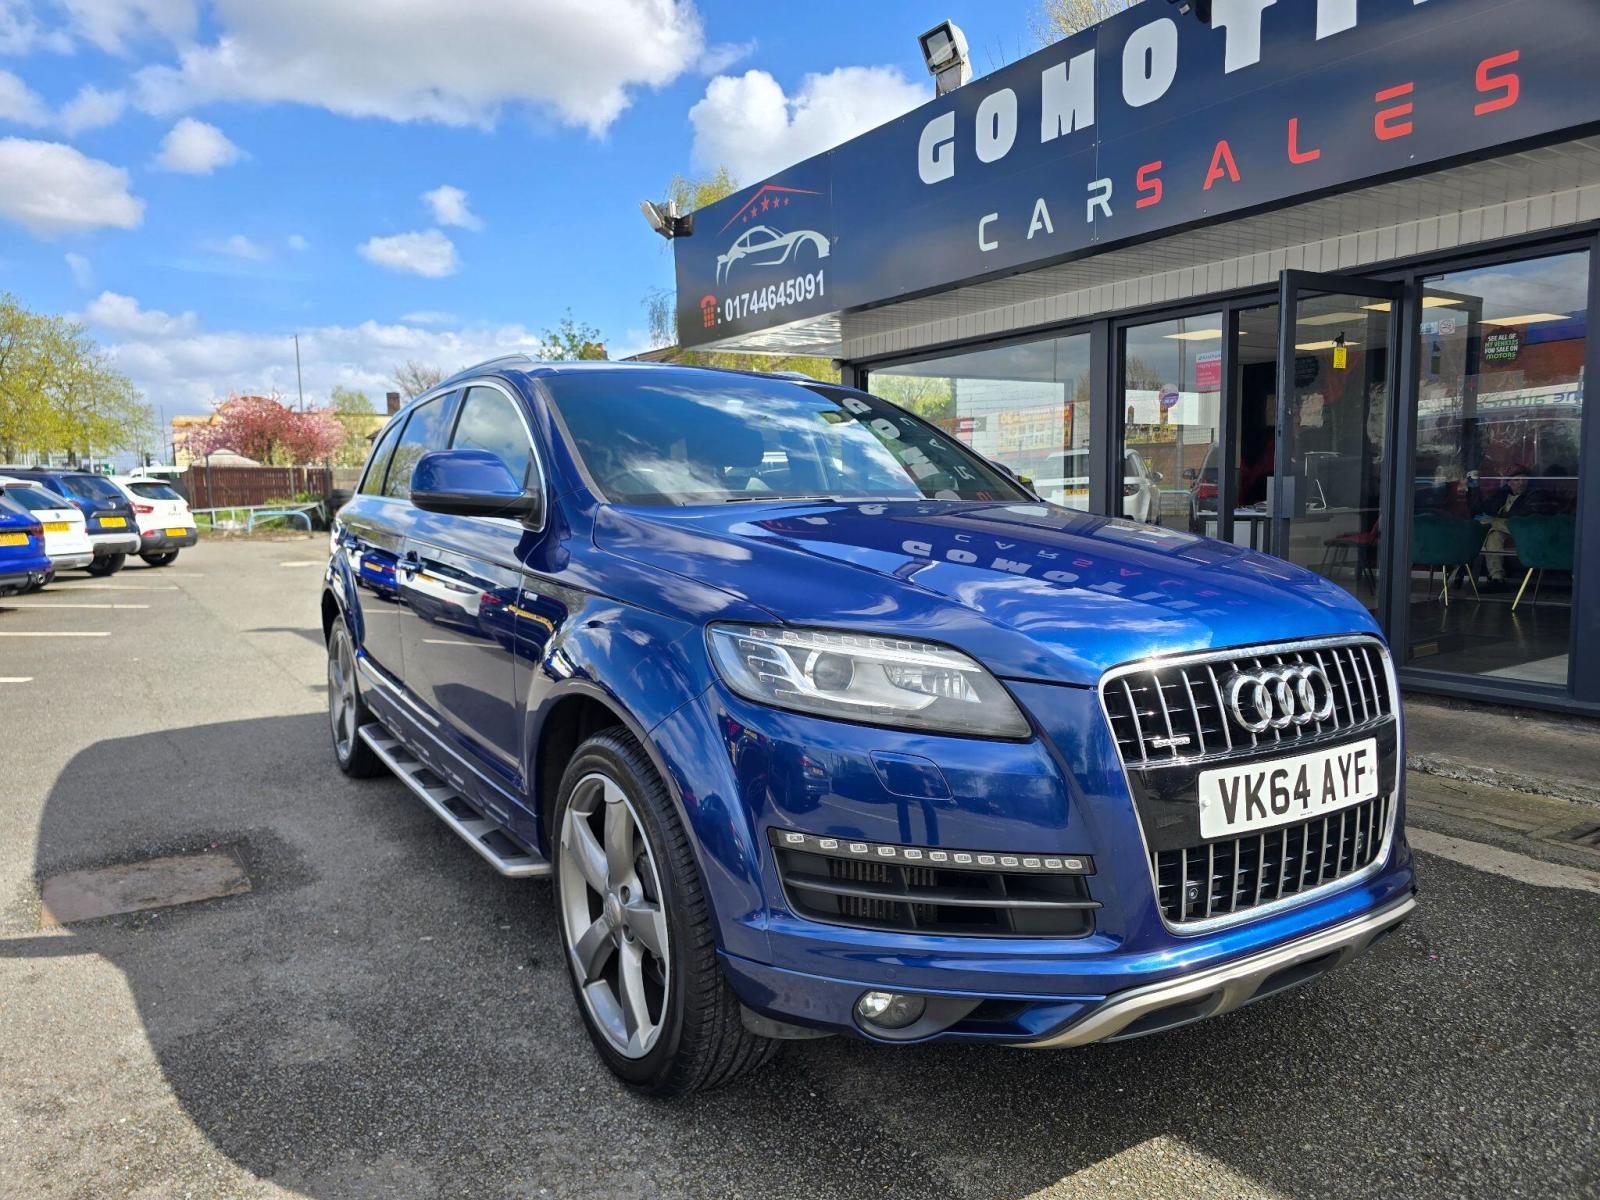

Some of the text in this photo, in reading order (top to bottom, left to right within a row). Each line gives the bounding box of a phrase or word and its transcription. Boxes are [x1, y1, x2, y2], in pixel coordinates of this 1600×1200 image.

[725, 269, 824, 322] 01744645091
[1218, 749, 1367, 825] VK64 AYF
